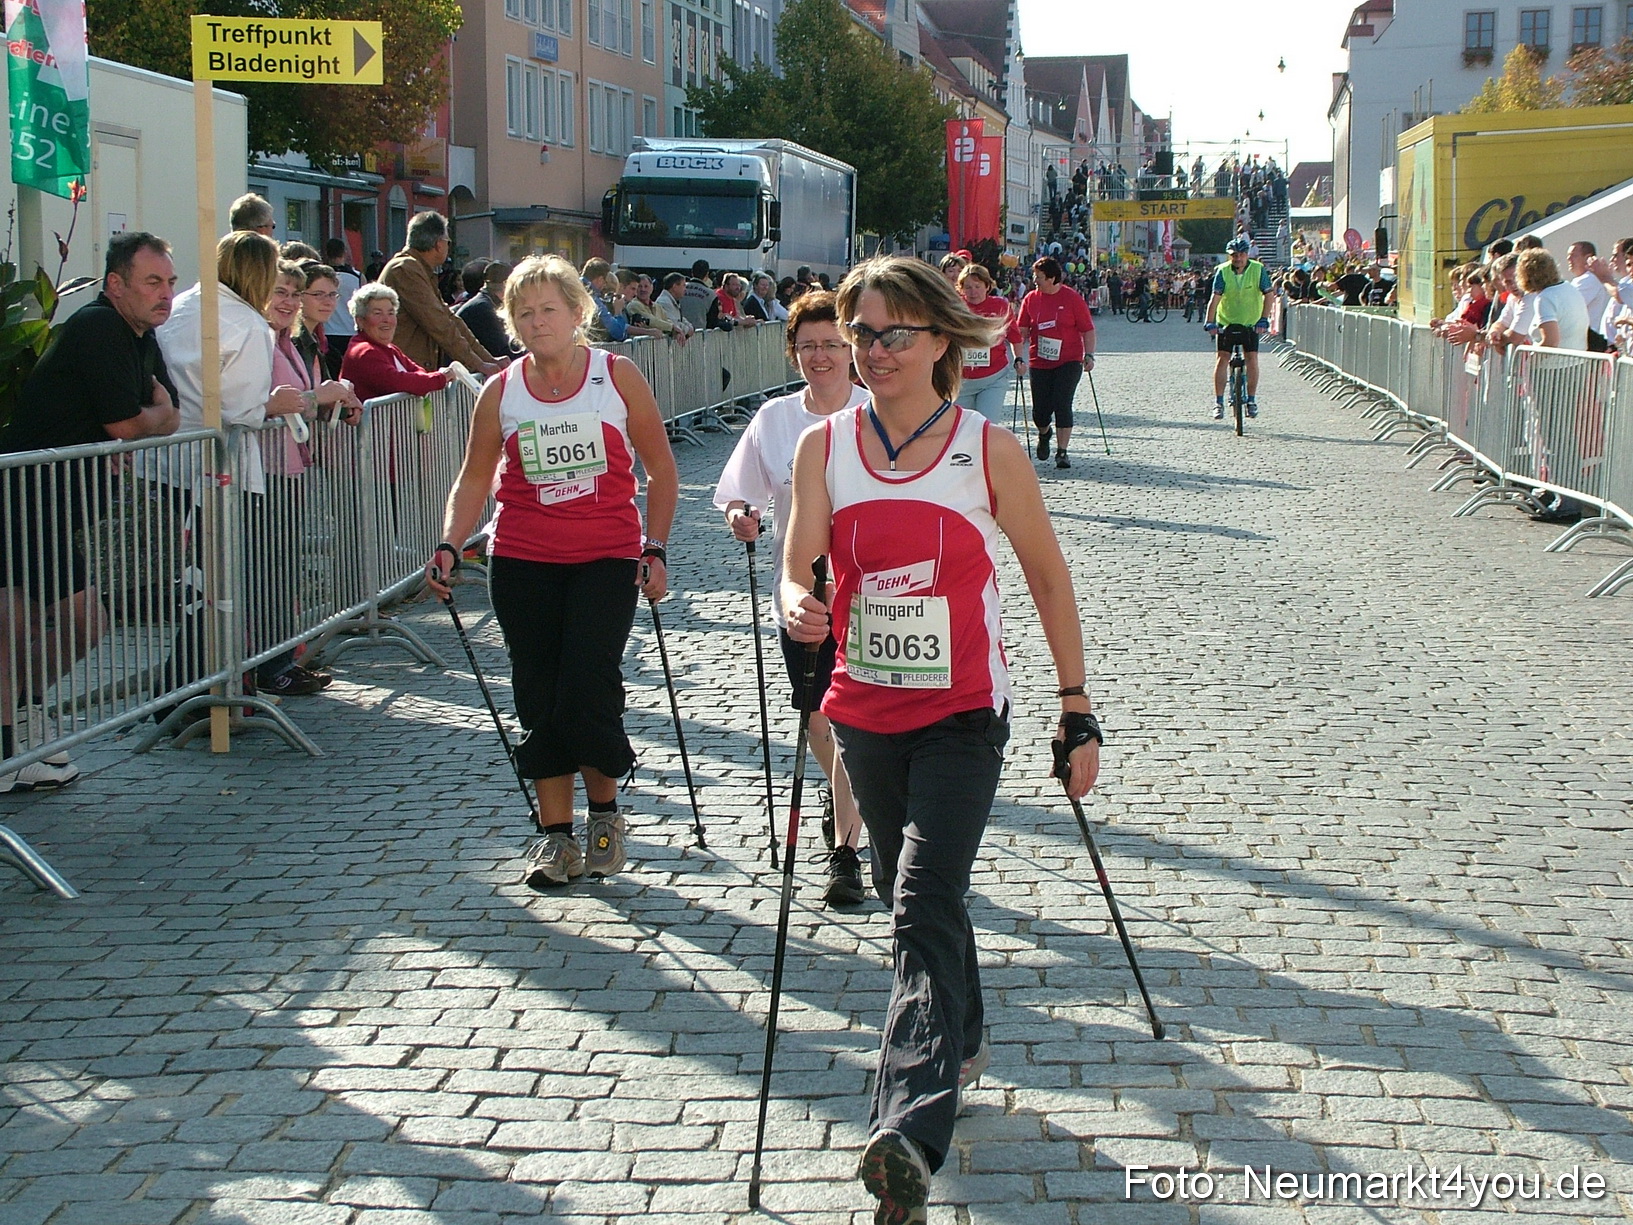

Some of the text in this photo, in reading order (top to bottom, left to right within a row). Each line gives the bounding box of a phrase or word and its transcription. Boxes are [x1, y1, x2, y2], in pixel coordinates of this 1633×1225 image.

[206, 22, 332, 49] Treffpunkt
[208, 51, 341, 79] Bladenight
[656, 156, 725, 170] BOCK
[1140, 203, 1188, 215] START
[967, 351, 988, 359] 5064
[540, 421, 578, 437] Martha
[523, 446, 534, 456] Sc
[546, 441, 597, 465] 5061
[555, 484, 580, 498] DEHN
[877, 573, 911, 591] DEHN
[864, 597, 924, 621] Irmgard
[869, 632, 941, 661] 5063
[903, 673, 949, 682] PFLEIDERER
